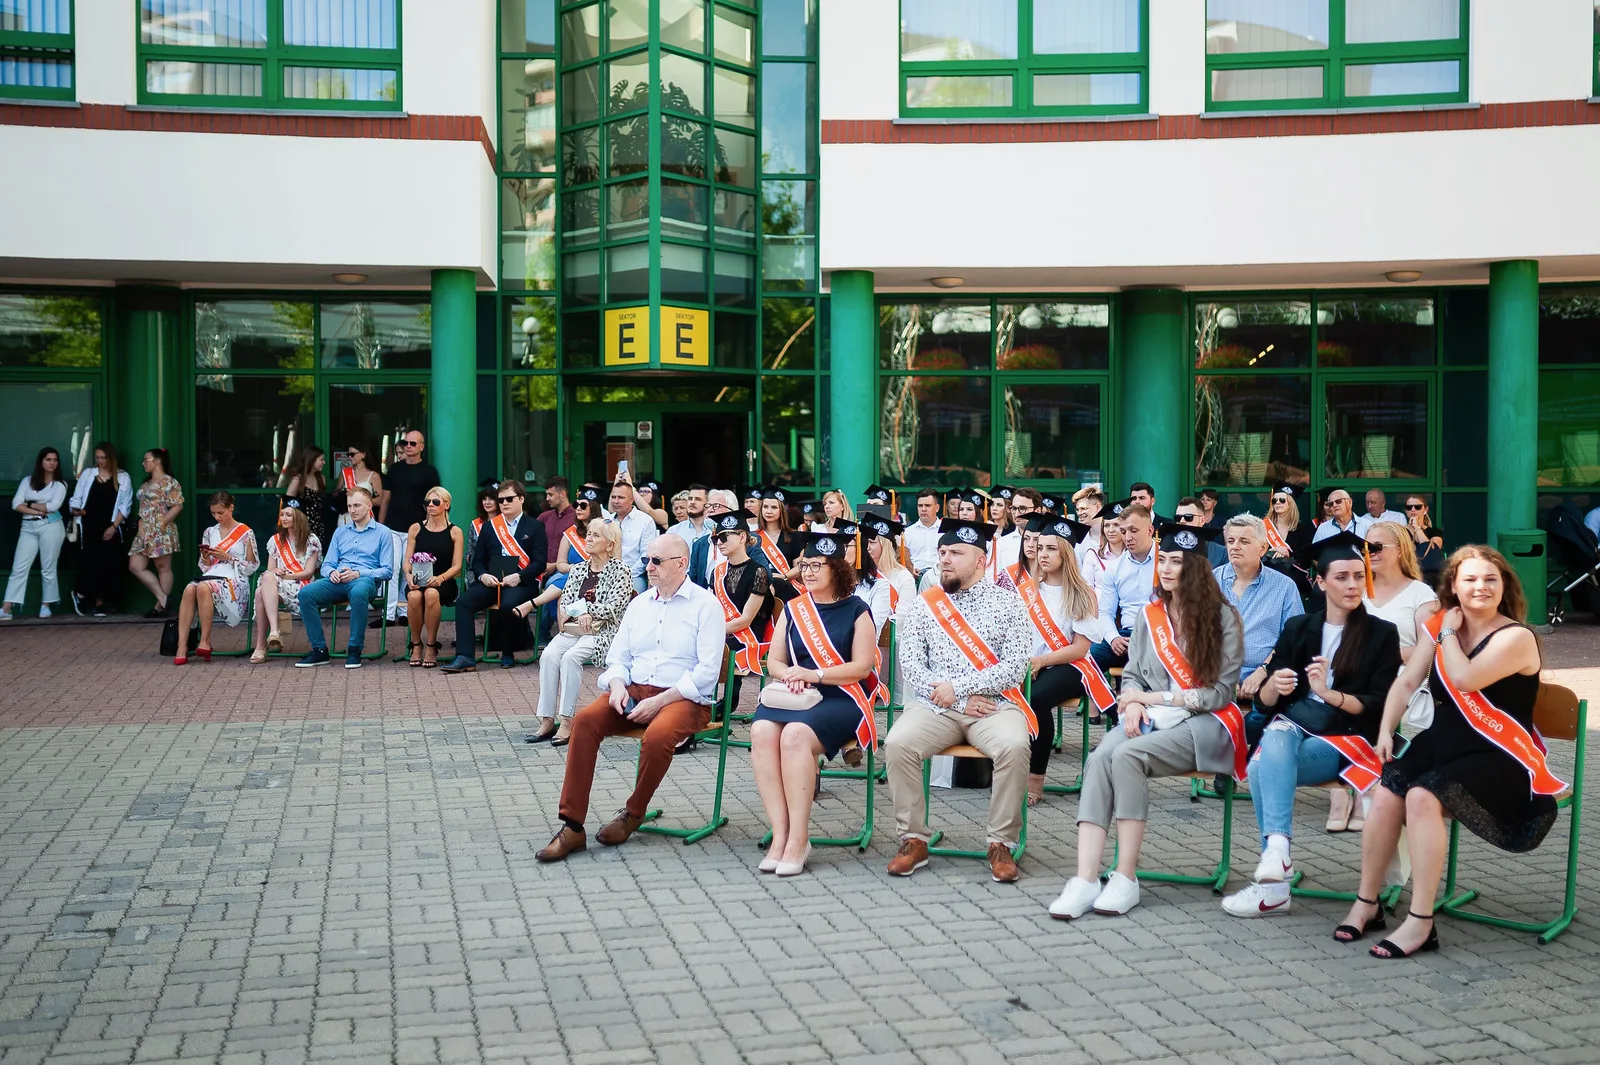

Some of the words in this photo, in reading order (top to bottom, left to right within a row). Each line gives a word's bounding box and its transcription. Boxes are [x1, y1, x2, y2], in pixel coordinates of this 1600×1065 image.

[619, 323, 635, 358] E
[676, 323, 693, 358] E
[796, 601, 816, 637] UCZELNIA
[936, 600, 961, 633] UCZELNIA
